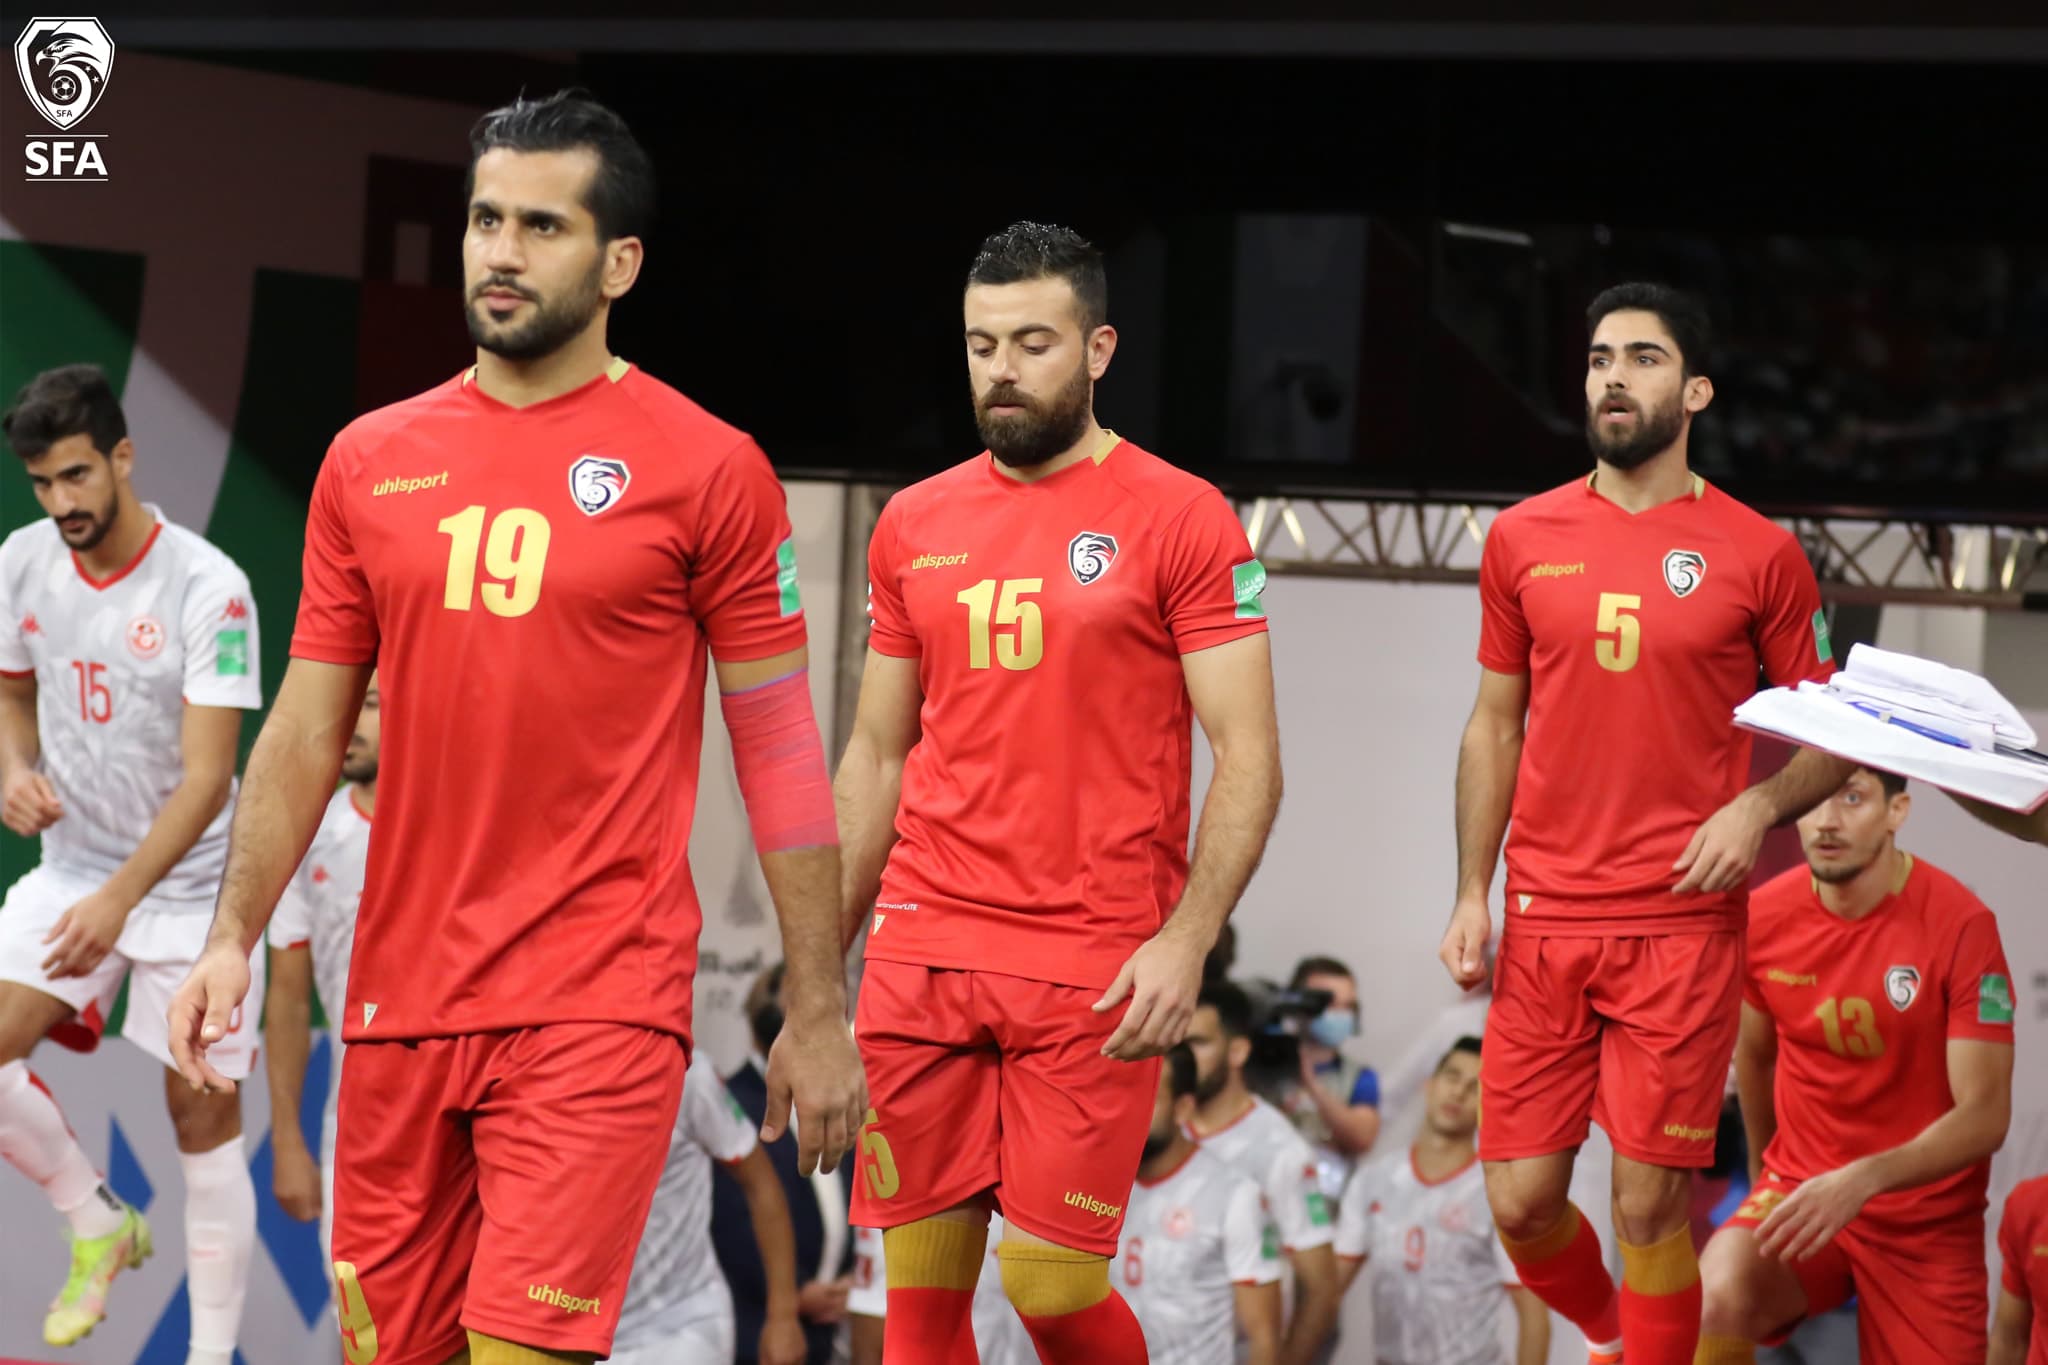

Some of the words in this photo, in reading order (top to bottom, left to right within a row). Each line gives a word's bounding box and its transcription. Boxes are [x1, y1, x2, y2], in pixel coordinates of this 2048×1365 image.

[373, 471, 449, 497] uhlsport
[437, 505, 551, 618] 19
[911, 551, 969, 570] uhlsport
[1530, 562, 1585, 577] uhlsport
[956, 578, 1044, 671] 15
[1595, 592, 1641, 673] 5
[71, 660, 113, 724] 15
[1814, 997, 1886, 1058] 13
[860, 1107, 899, 1199] 5
[1663, 1124, 1715, 1141] uhlspor
[1124, 1236, 1144, 1288] 6
[1403, 1226, 1425, 1273] 9
[528, 1284, 600, 1315] uhlsport
